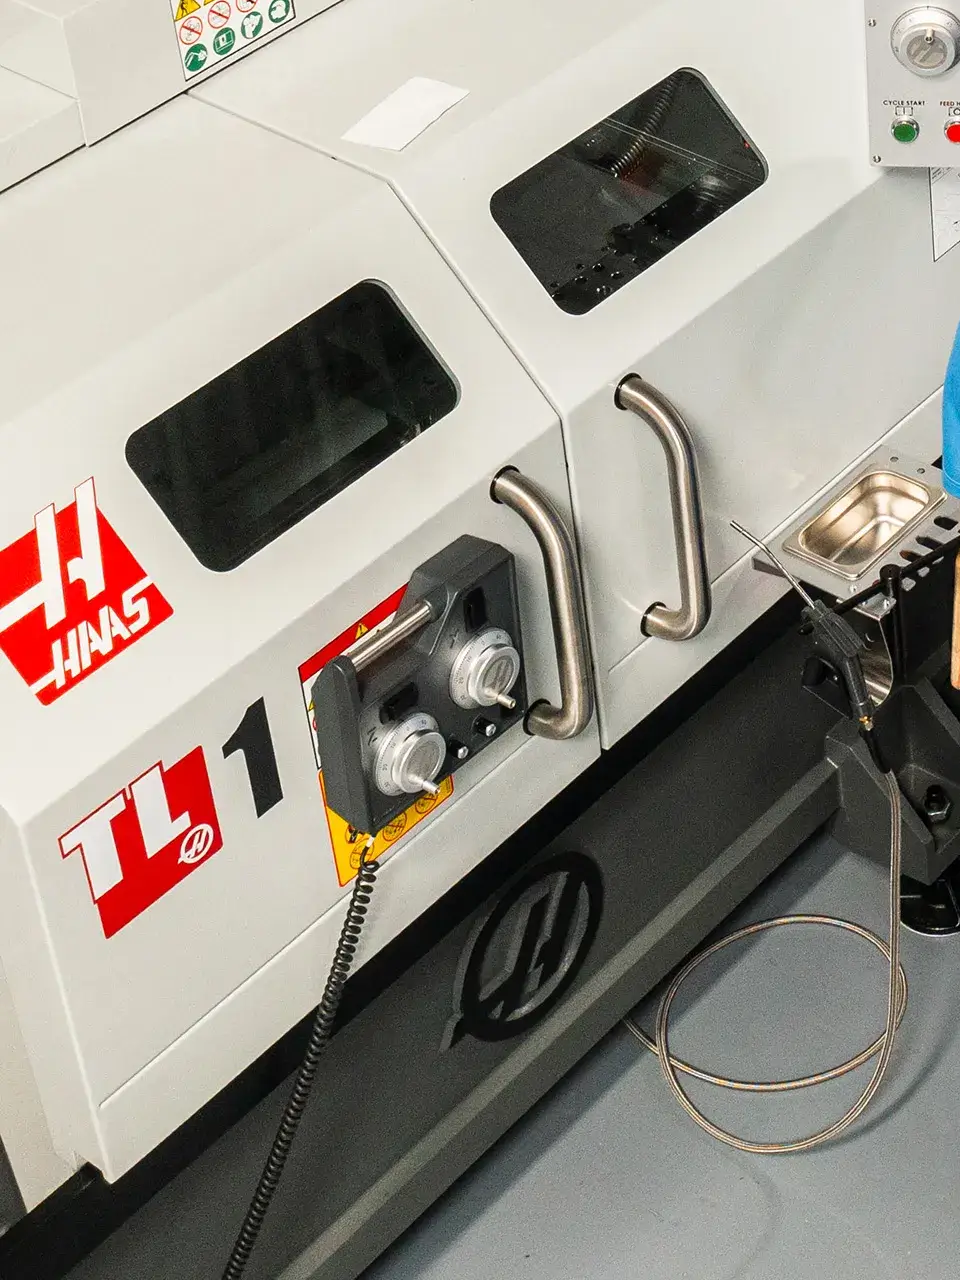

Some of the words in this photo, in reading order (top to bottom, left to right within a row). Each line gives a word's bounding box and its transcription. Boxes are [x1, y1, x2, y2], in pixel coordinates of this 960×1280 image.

[29, 575, 154, 691] HAAS
[60, 763, 191, 903] TL
[222, 696, 284, 819] 1
